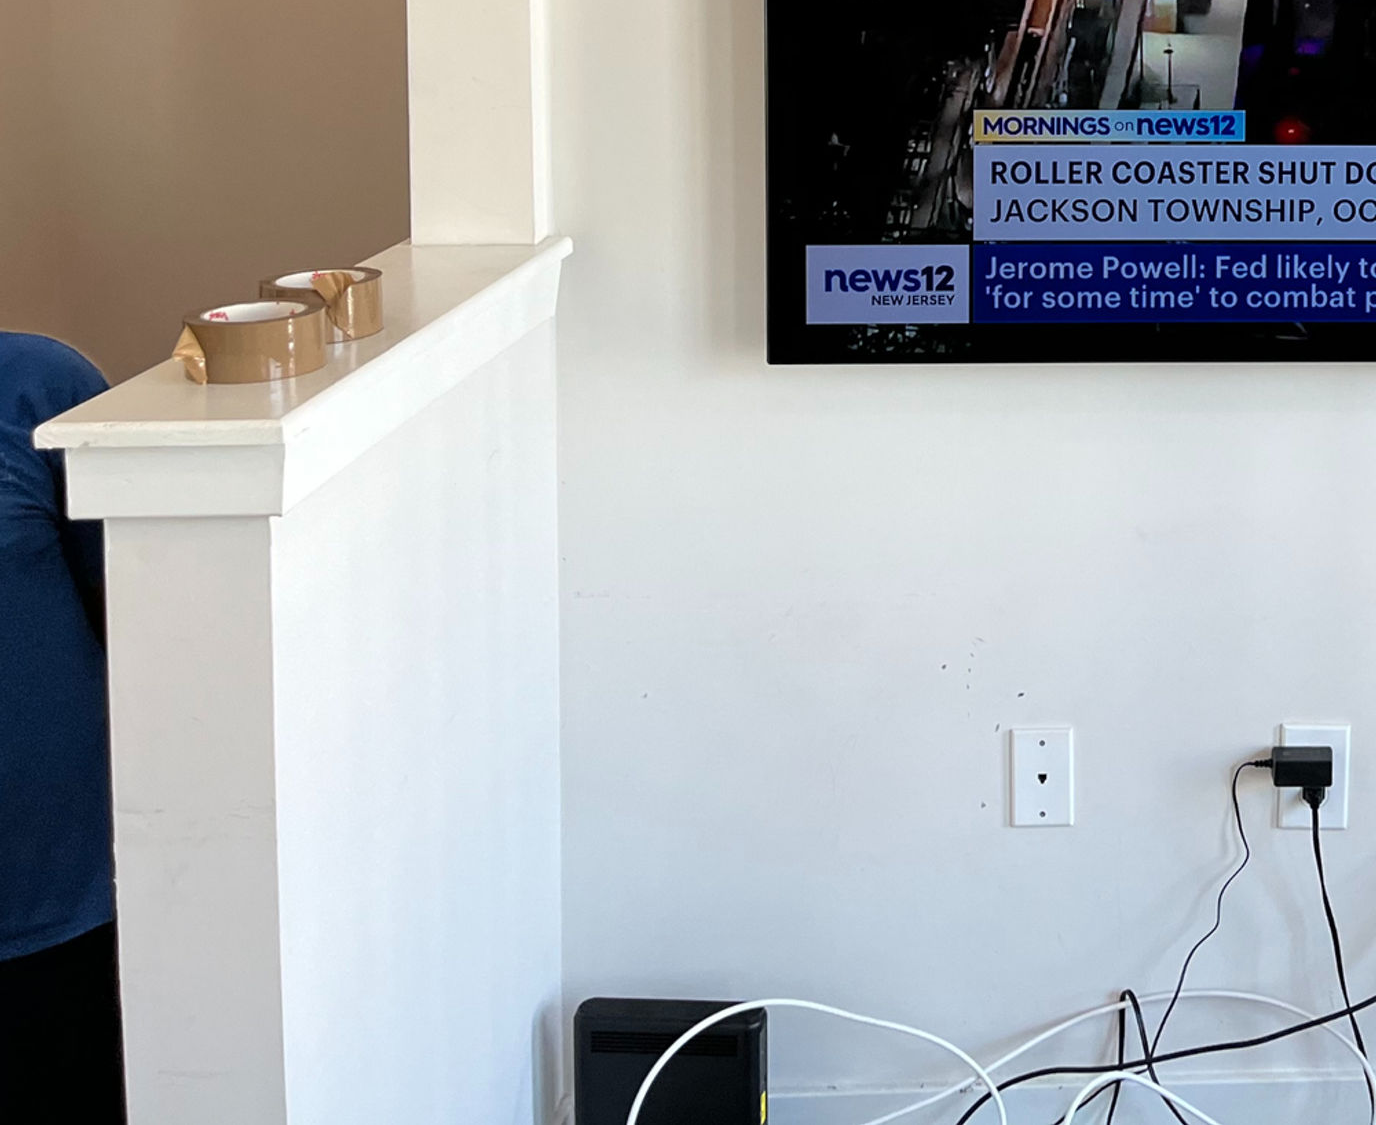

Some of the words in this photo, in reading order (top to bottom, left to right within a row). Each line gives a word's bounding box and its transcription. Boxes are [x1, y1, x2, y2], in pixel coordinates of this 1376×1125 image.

[983, 116, 1111, 136] MORNINGS
[1114, 121, 1135, 132] on
[1136, 114, 1236, 136] news12
[991, 160, 1103, 185] ROLLER
[1111, 160, 1250, 185] COASTER
[1258, 160, 1337, 185] SHUT
[989, 198, 1138, 223] JACKSON
[1147, 198, 1323, 226] TOWNSHIP,
[824, 264, 955, 293] news12
[985, 256, 1094, 280] Jerome
[1103, 254, 1205, 279] Powell:
[1216, 254, 1267, 279] Fed
[1277, 254, 1350, 284] likely
[871, 294, 904, 306] NEW
[906, 294, 955, 306] JERSEY
[985, 284, 1033, 309] 'for
[1041, 291, 1121, 309] some
[1129, 284, 1200, 308] time'
[1208, 287, 1238, 308] to
[1246, 285, 1356, 308] combat
